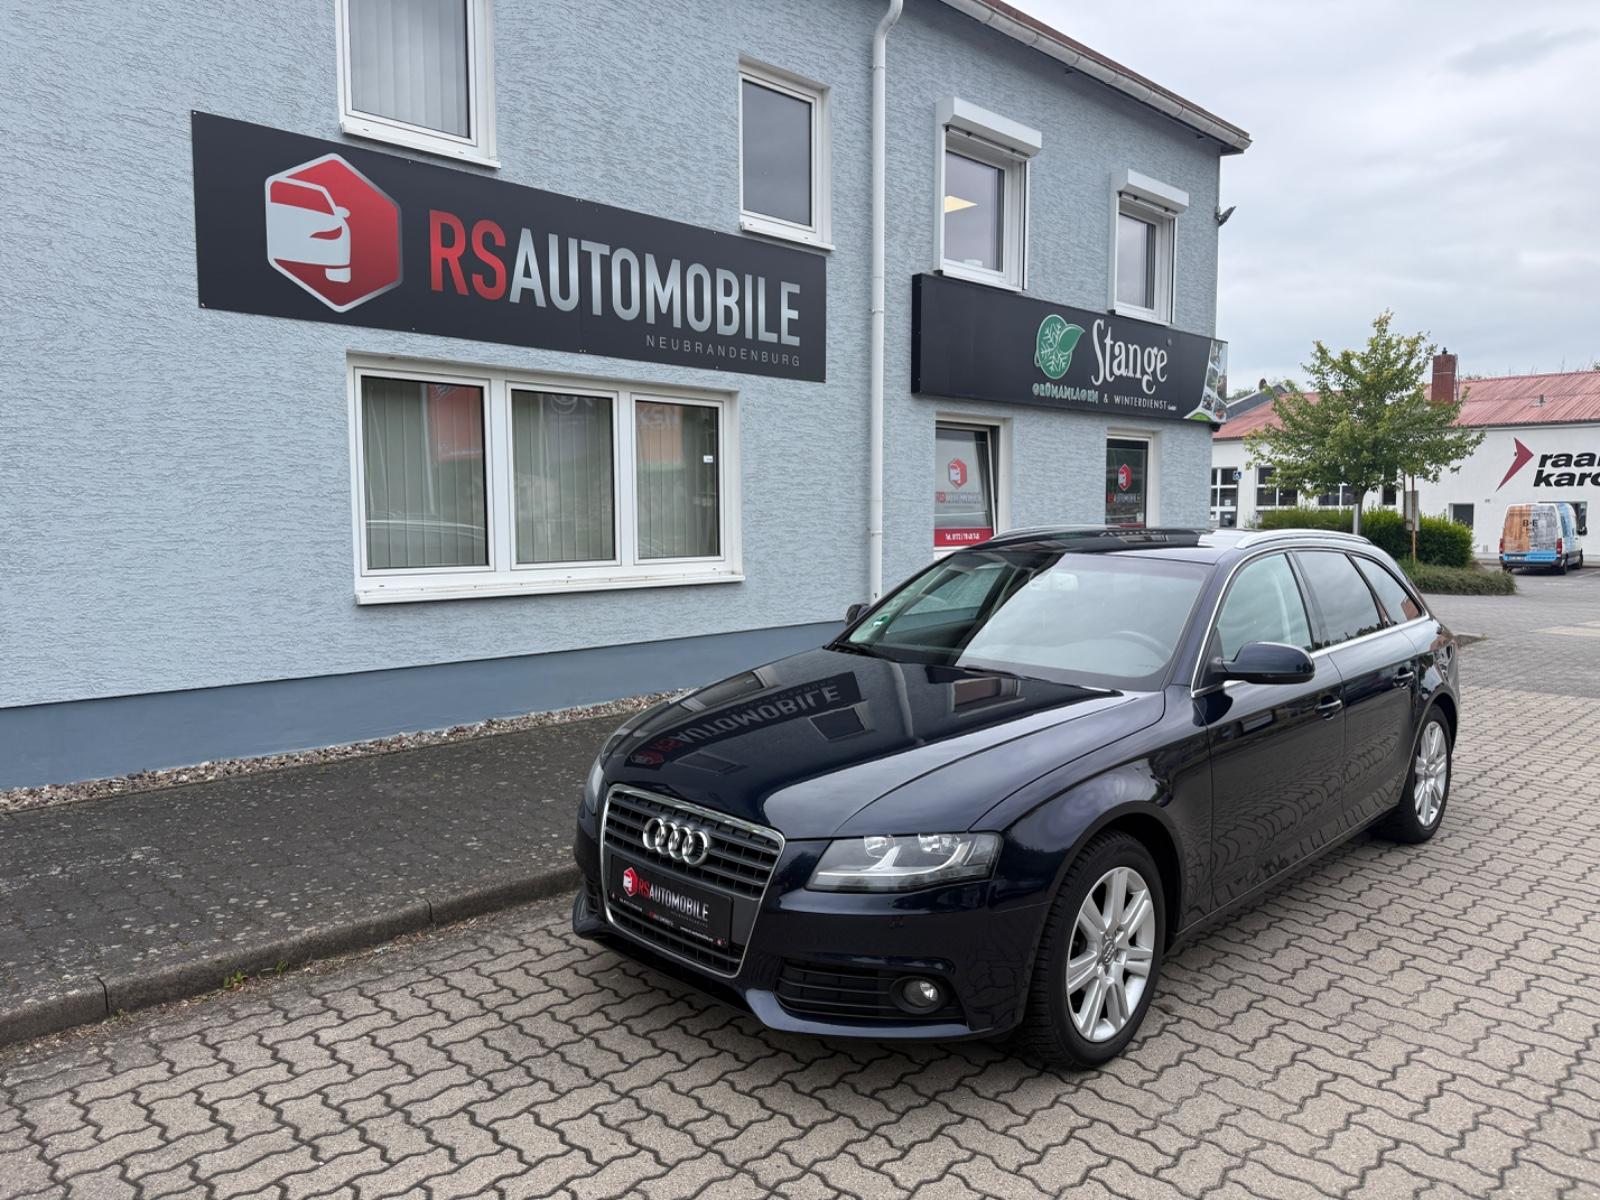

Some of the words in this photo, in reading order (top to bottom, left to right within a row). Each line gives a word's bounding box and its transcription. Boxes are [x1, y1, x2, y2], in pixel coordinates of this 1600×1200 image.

[646, 335, 800, 367] NEUBRANDENBURG
[1091, 319, 1168, 394] Stange
[1103, 394, 1109, 404] &
[1114, 394, 1168, 411] WINTERDIENST
[1538, 452, 1600, 468] raa
